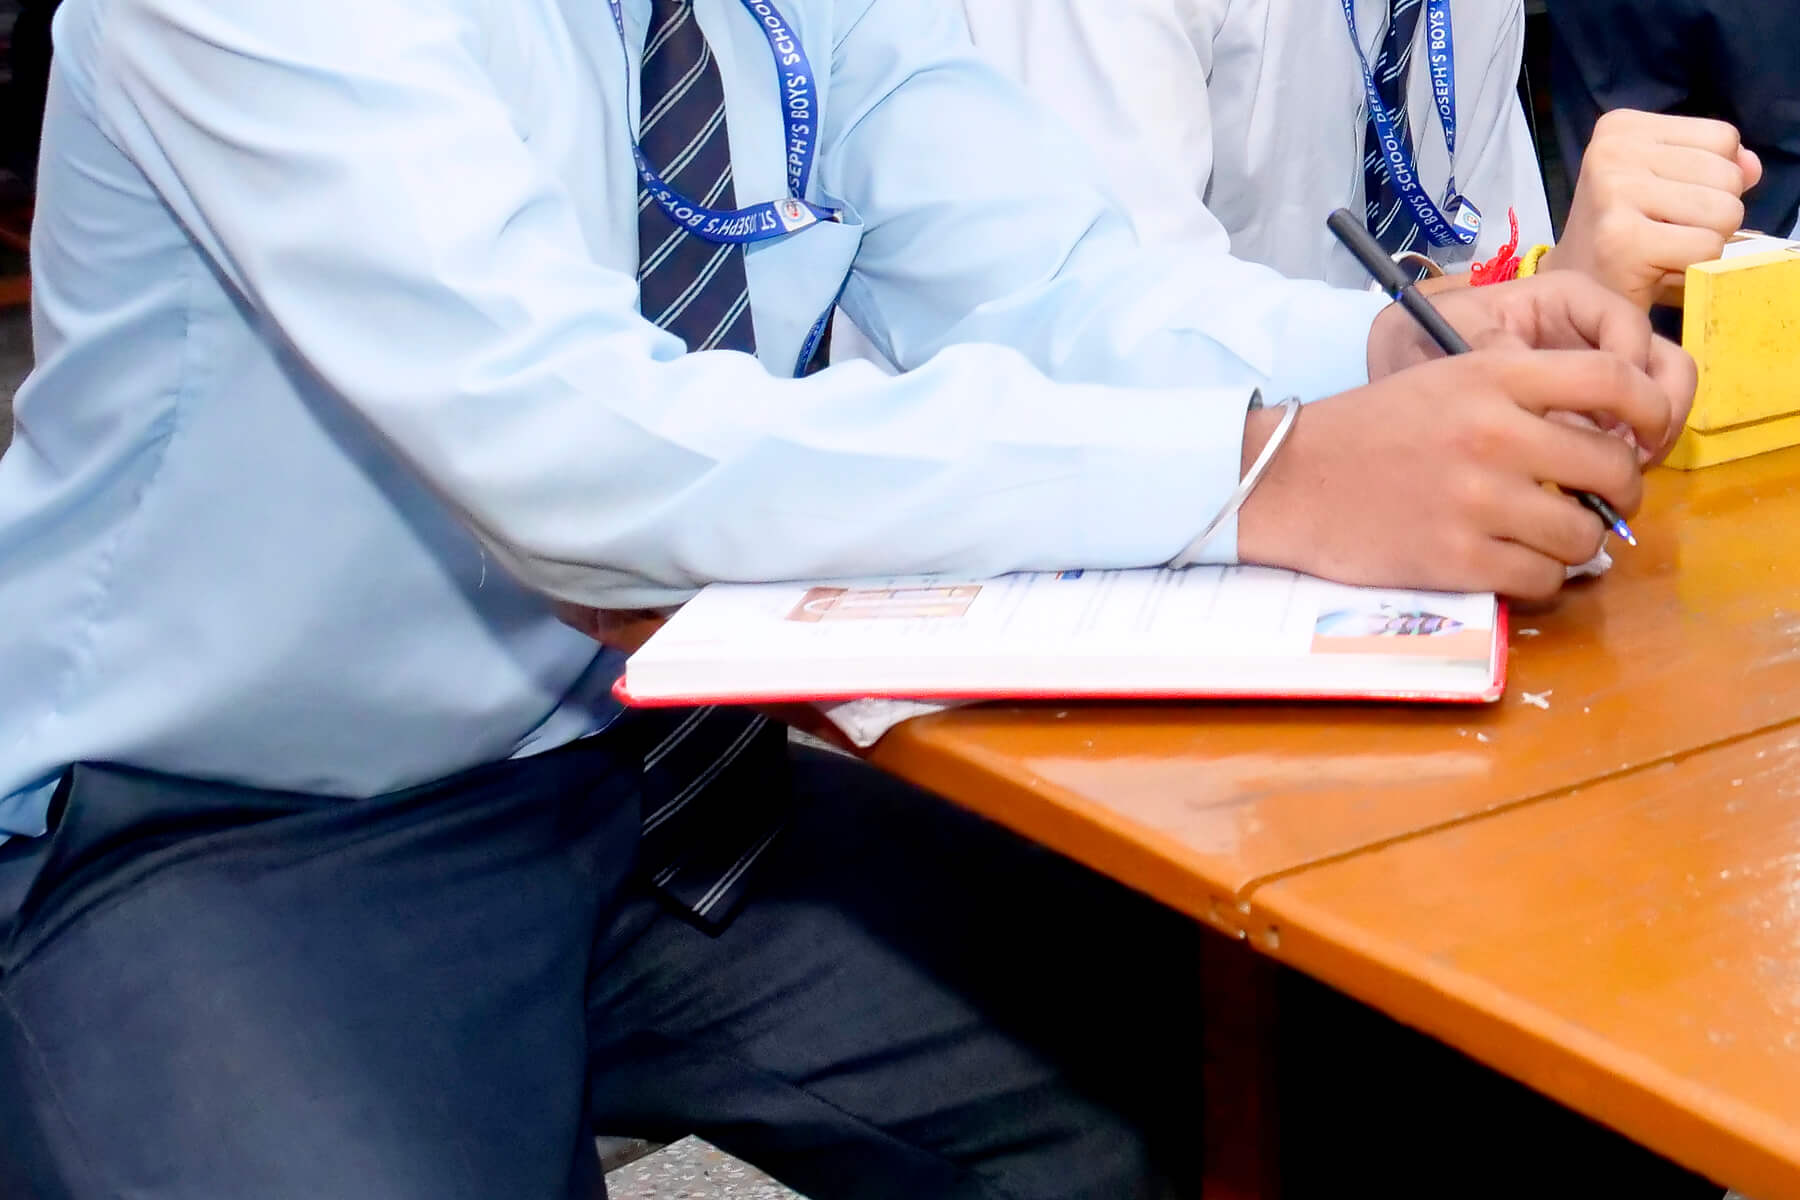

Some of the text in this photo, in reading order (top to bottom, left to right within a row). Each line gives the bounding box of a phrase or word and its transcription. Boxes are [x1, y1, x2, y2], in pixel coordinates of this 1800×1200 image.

[1430, 7, 1444, 50] BOYS'
[786, 72, 809, 119] BOYS'
[1432, 55, 1452, 123] JOSEPH'S
[1383, 128, 1417, 191] SCHOOL,
[652, 187, 706, 226] BOYS'
